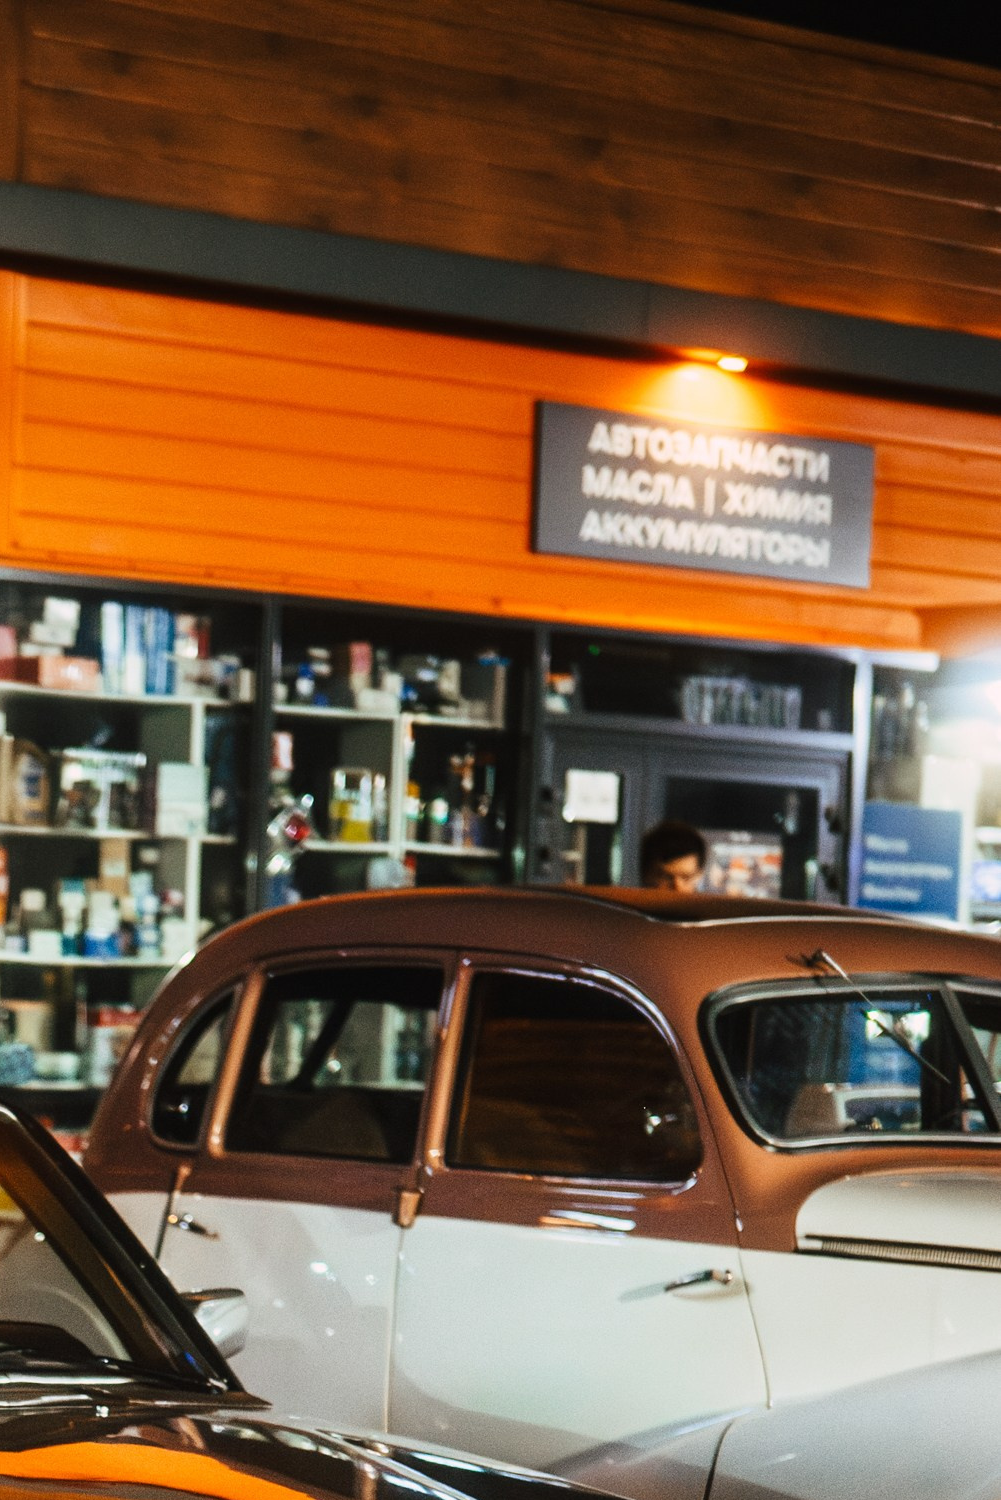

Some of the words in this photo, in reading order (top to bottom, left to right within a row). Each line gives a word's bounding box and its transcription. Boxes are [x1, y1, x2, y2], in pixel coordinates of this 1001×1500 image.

[589, 423, 830, 482] АВТОЗАПЧАСТИ
[582, 466, 696, 509] МАСЛА
[723, 484, 832, 525] ХИМИЯ
[580, 511, 830, 568] АККУМУЛЯТОРЫ
